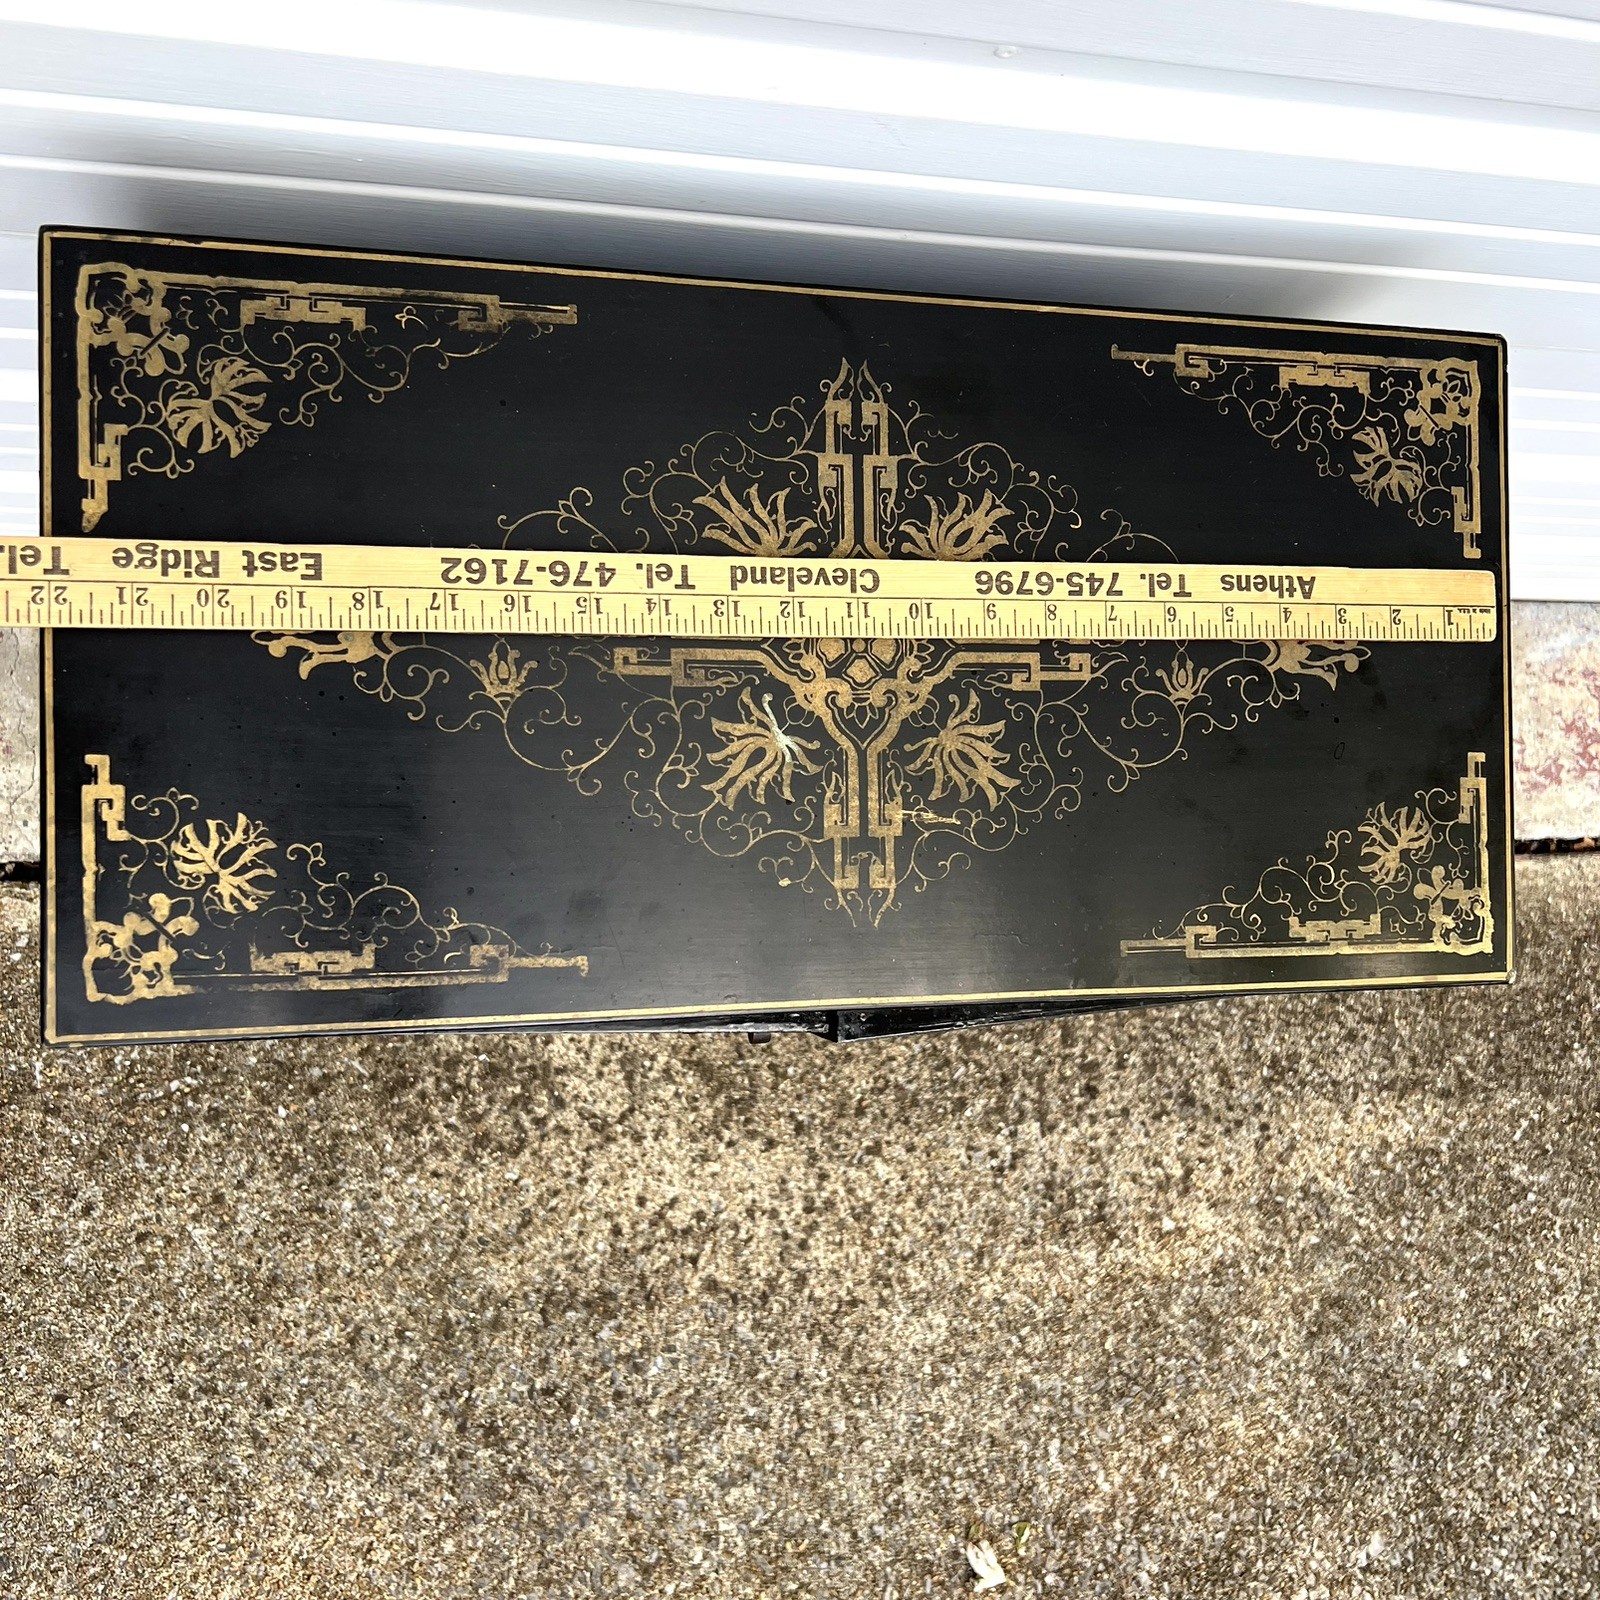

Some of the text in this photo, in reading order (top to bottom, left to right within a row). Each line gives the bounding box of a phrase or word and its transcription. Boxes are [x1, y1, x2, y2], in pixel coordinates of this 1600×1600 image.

[111, 542, 221, 579] Ridge
[241, 549, 323, 581] East
[440, 557, 881, 594] Cleveland Tel. 476-7162
[974, 570, 1316, 600] Athens Tel. 745-6796
[986, 603, 997, 620] 9
[1046, 604, 1057, 621] 8
[1107, 605, 1118, 622] 7
[1166, 606, 1177, 623] 6
[1224, 606, 1234, 623] 5
[1282, 607, 1292, 624] 4
[1337, 607, 1347, 625] 3
[1392, 608, 1402, 626] 2
[1445, 609, 1454, 626] 1
